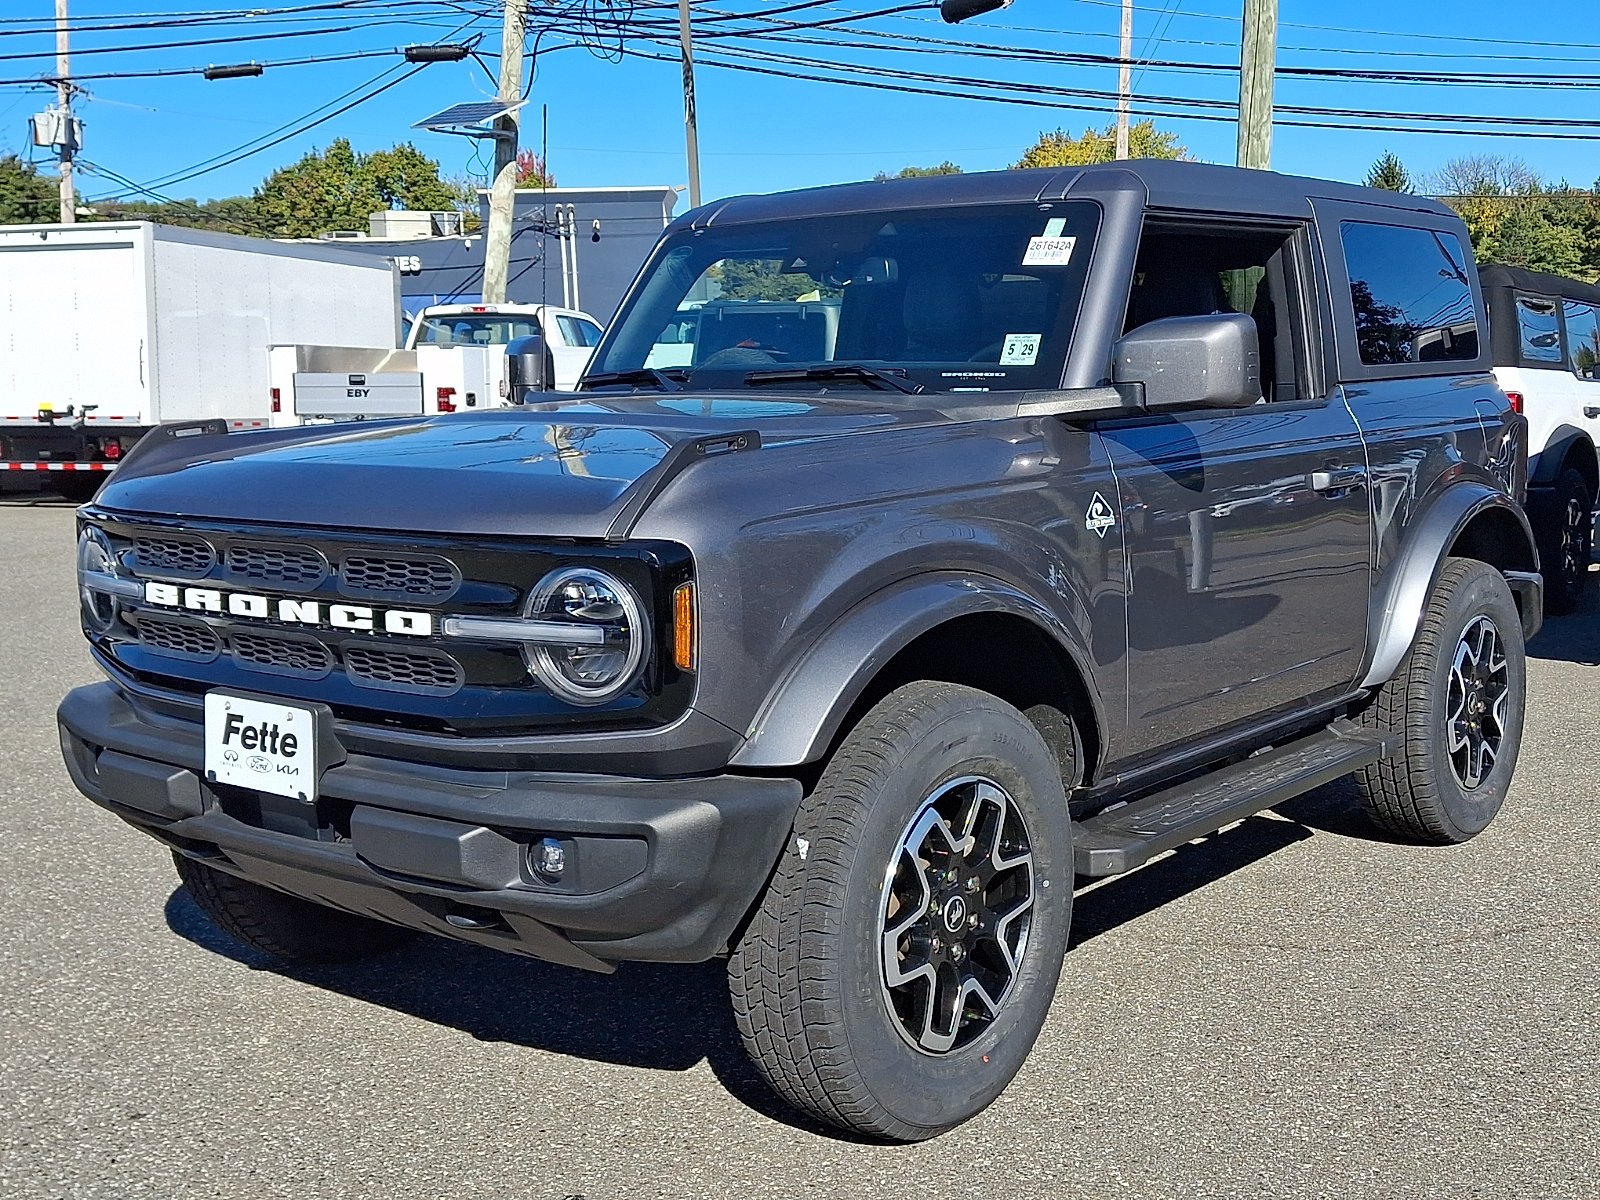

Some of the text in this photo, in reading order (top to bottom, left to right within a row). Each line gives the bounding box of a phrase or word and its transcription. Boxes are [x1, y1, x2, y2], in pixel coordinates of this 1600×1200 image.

[1029, 241, 1072, 251] 26T642A
[1008, 343, 1034, 356] 5 29
[346, 388, 370, 397] EBY
[145, 582, 432, 636] BRONCO
[222, 712, 298, 758] Fette
[250, 757, 270, 771] Ford
